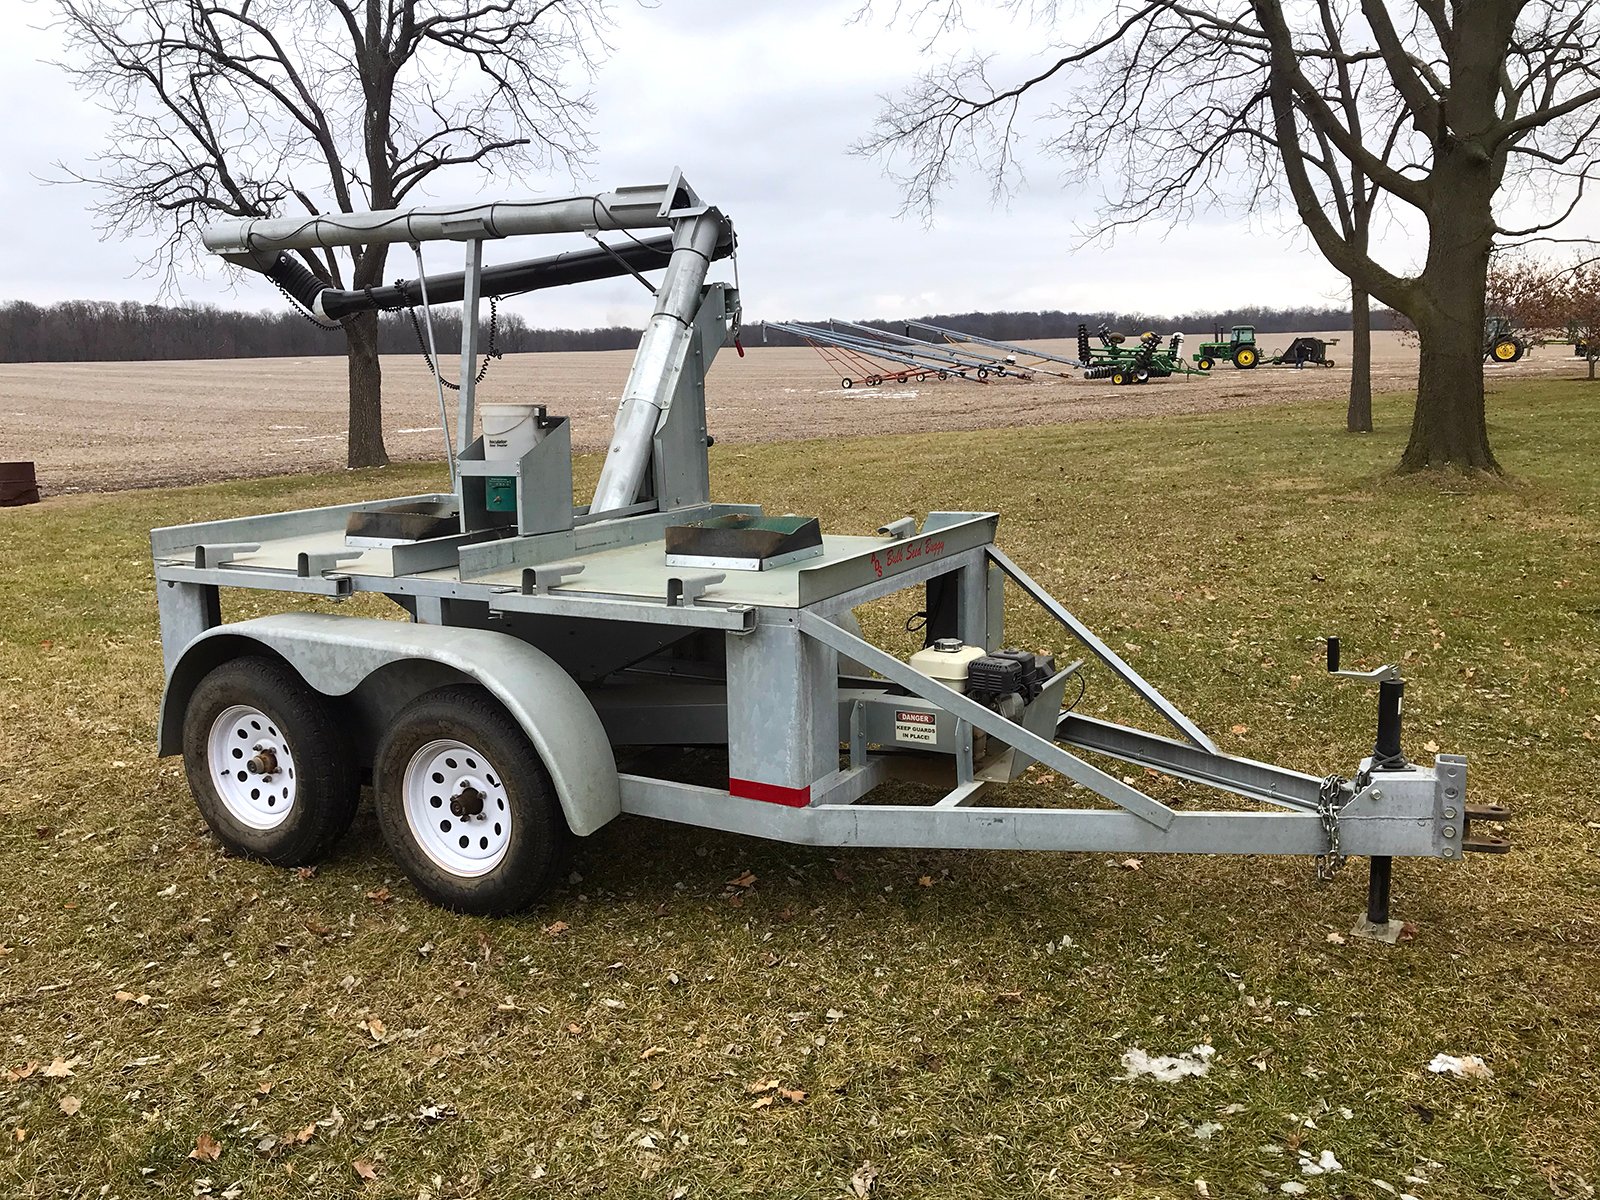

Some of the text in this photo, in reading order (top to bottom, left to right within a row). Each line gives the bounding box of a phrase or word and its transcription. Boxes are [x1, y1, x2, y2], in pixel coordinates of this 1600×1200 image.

[886, 548, 903, 567] Bulk
[905, 543, 923, 561] Seed
[924, 537, 945, 557] Buggy
[902, 713, 929, 722] DANGER
[912, 726, 936, 734] GUARDS
